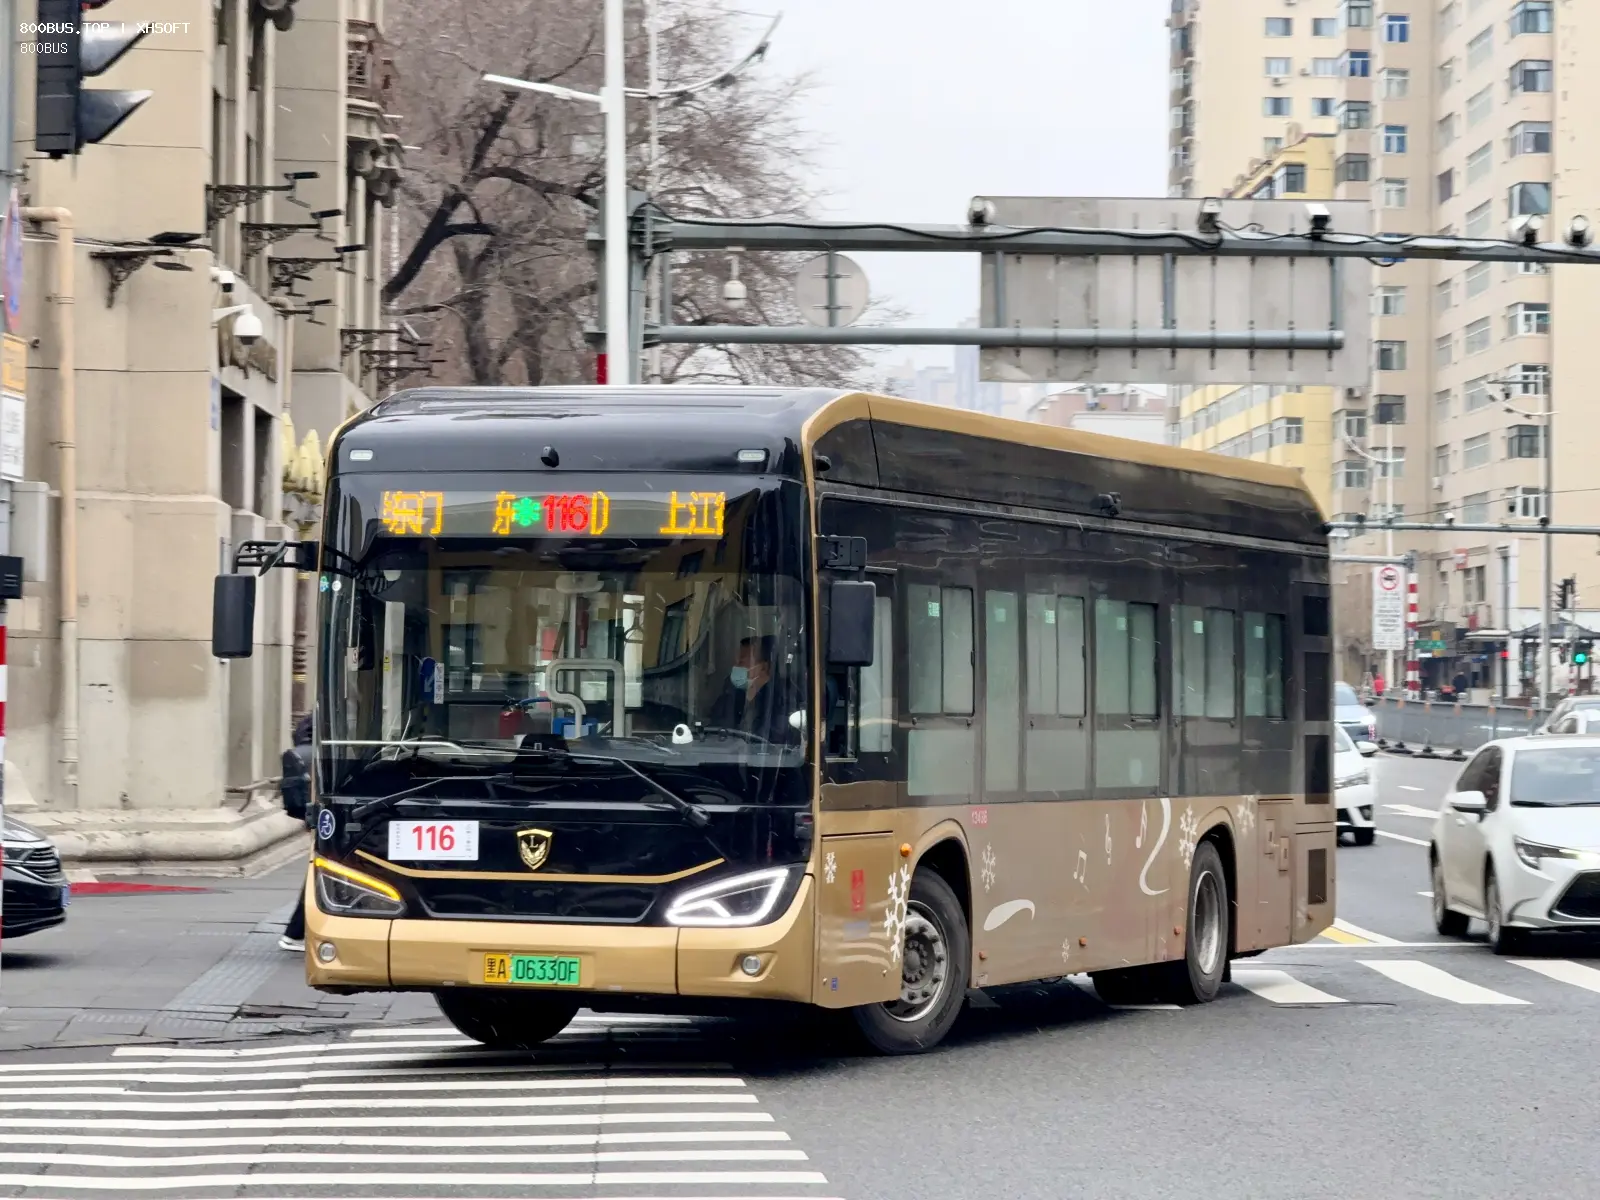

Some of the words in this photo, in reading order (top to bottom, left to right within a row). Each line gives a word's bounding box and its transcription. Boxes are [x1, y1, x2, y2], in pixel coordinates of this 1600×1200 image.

[543, 495, 589, 531] 116
[412, 825, 455, 851] 116
[515, 959, 578, 981] 06330F
